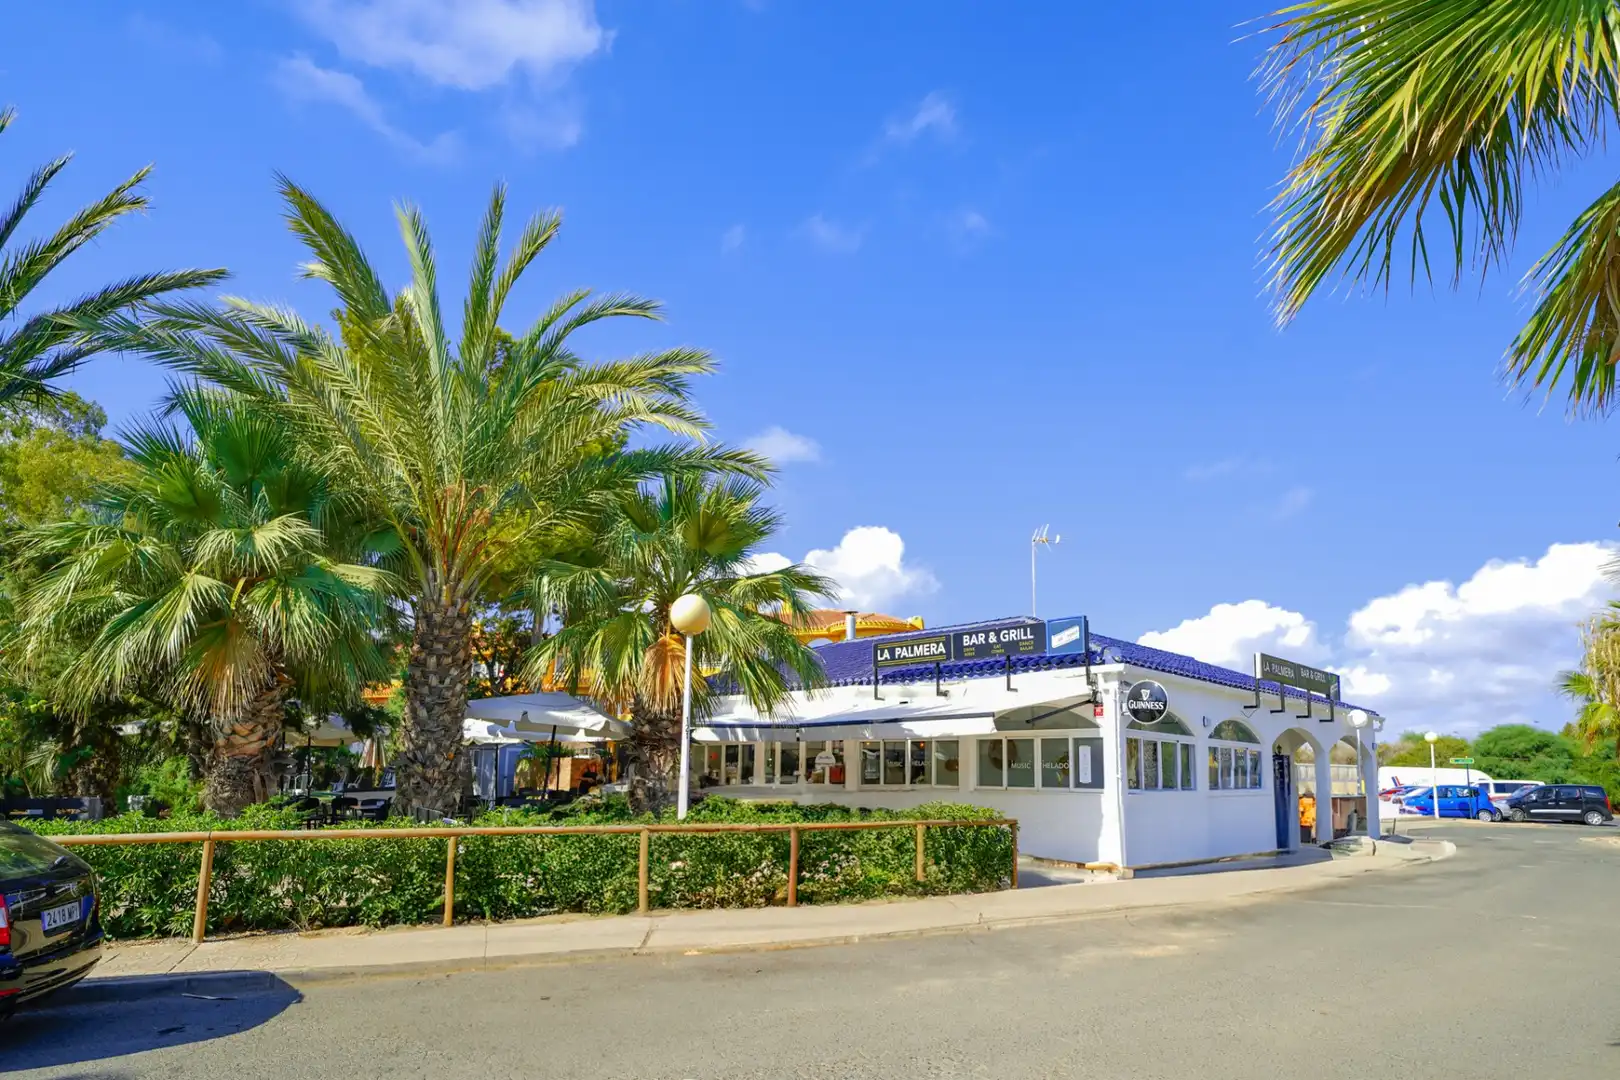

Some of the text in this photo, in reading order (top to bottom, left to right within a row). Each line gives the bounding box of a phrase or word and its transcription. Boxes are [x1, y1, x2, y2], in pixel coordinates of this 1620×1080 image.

[963, 627, 1034, 646] BAR & GRILL
[877, 642, 946, 661] LA PALMERA
[1263, 661, 1295, 679] LA PALMERA
[1300, 667, 1326, 683] BAR & GRILL
[1128, 699, 1164, 710] GUINNESS
[47, 908, 66, 927] 2418
